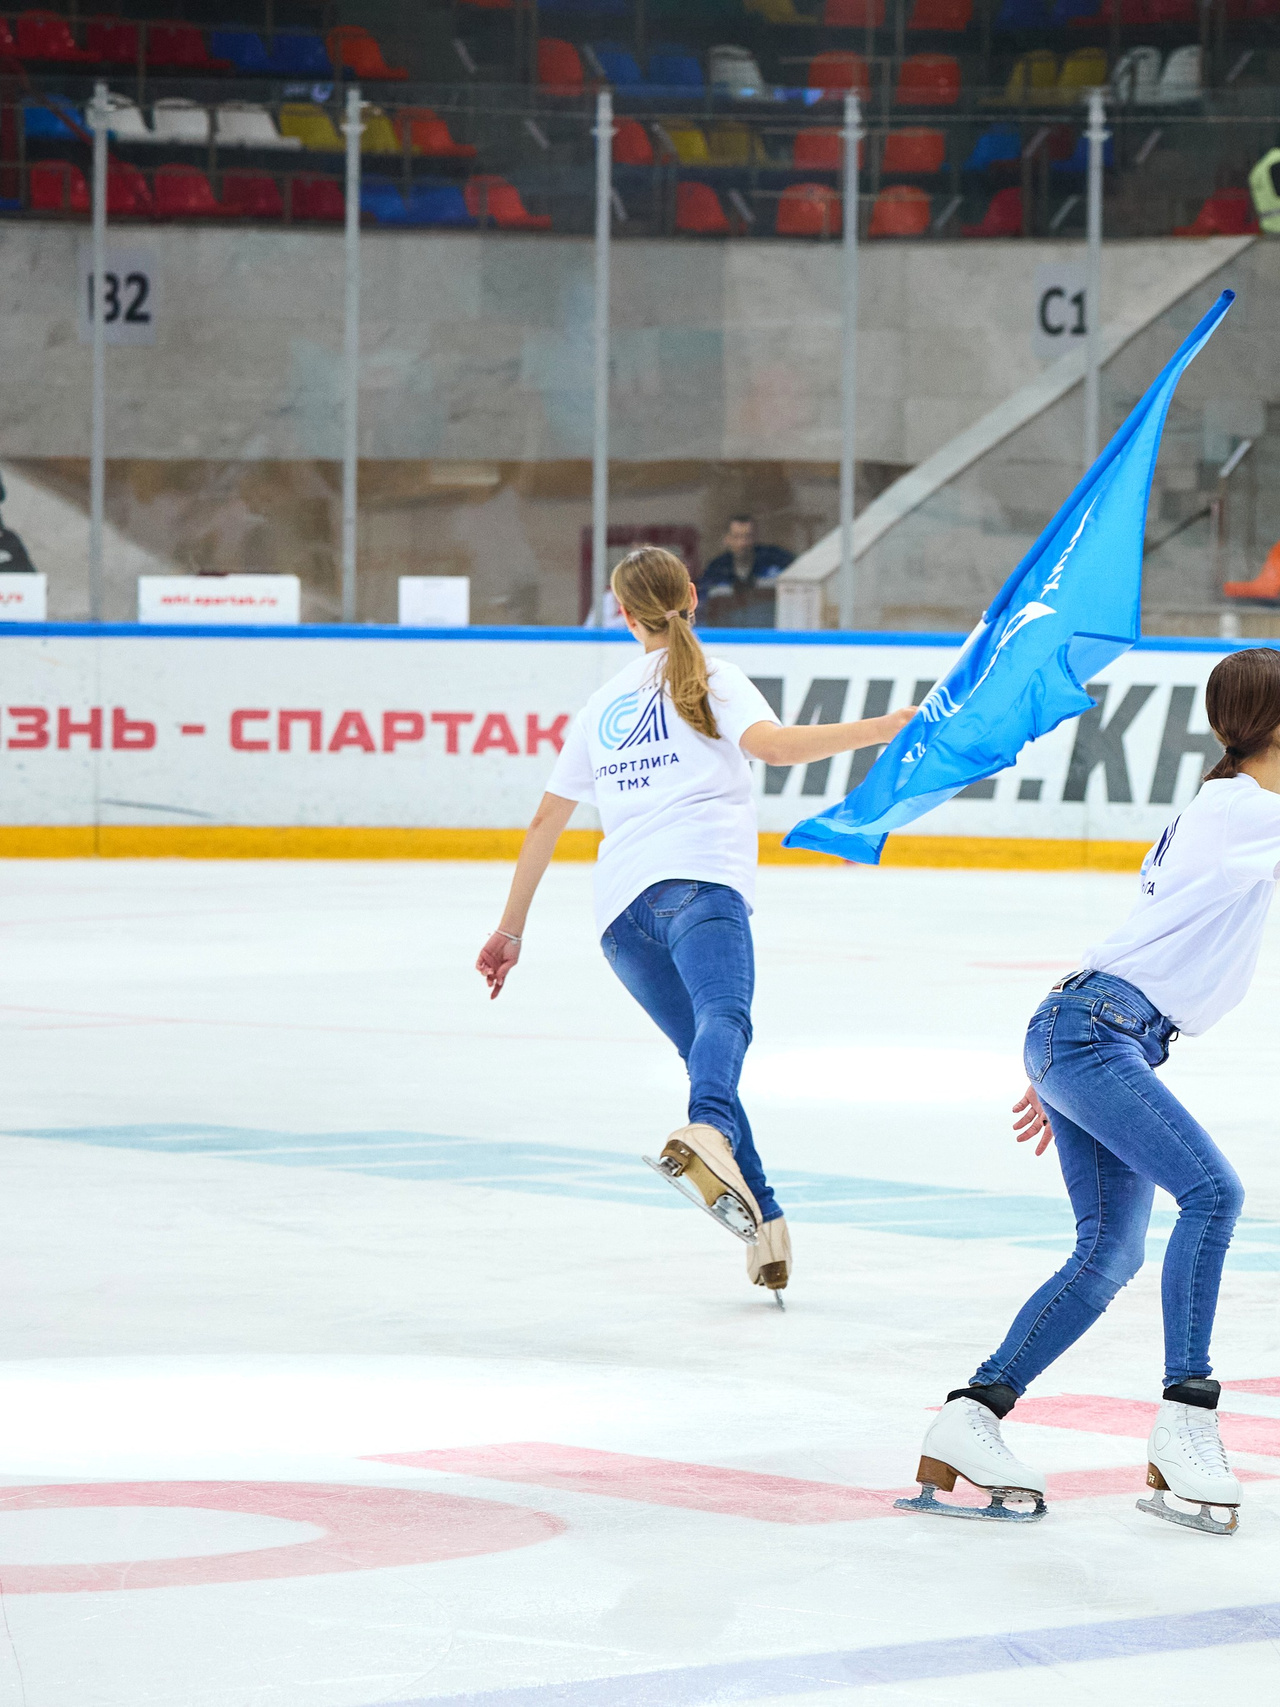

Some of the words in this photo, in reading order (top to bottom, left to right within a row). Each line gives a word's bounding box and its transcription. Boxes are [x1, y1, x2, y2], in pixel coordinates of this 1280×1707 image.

[0, 706, 157, 751] ЗНЬ
[229, 708, 571, 756] СПАРТАК
[617, 776, 650, 791] ТМХ
